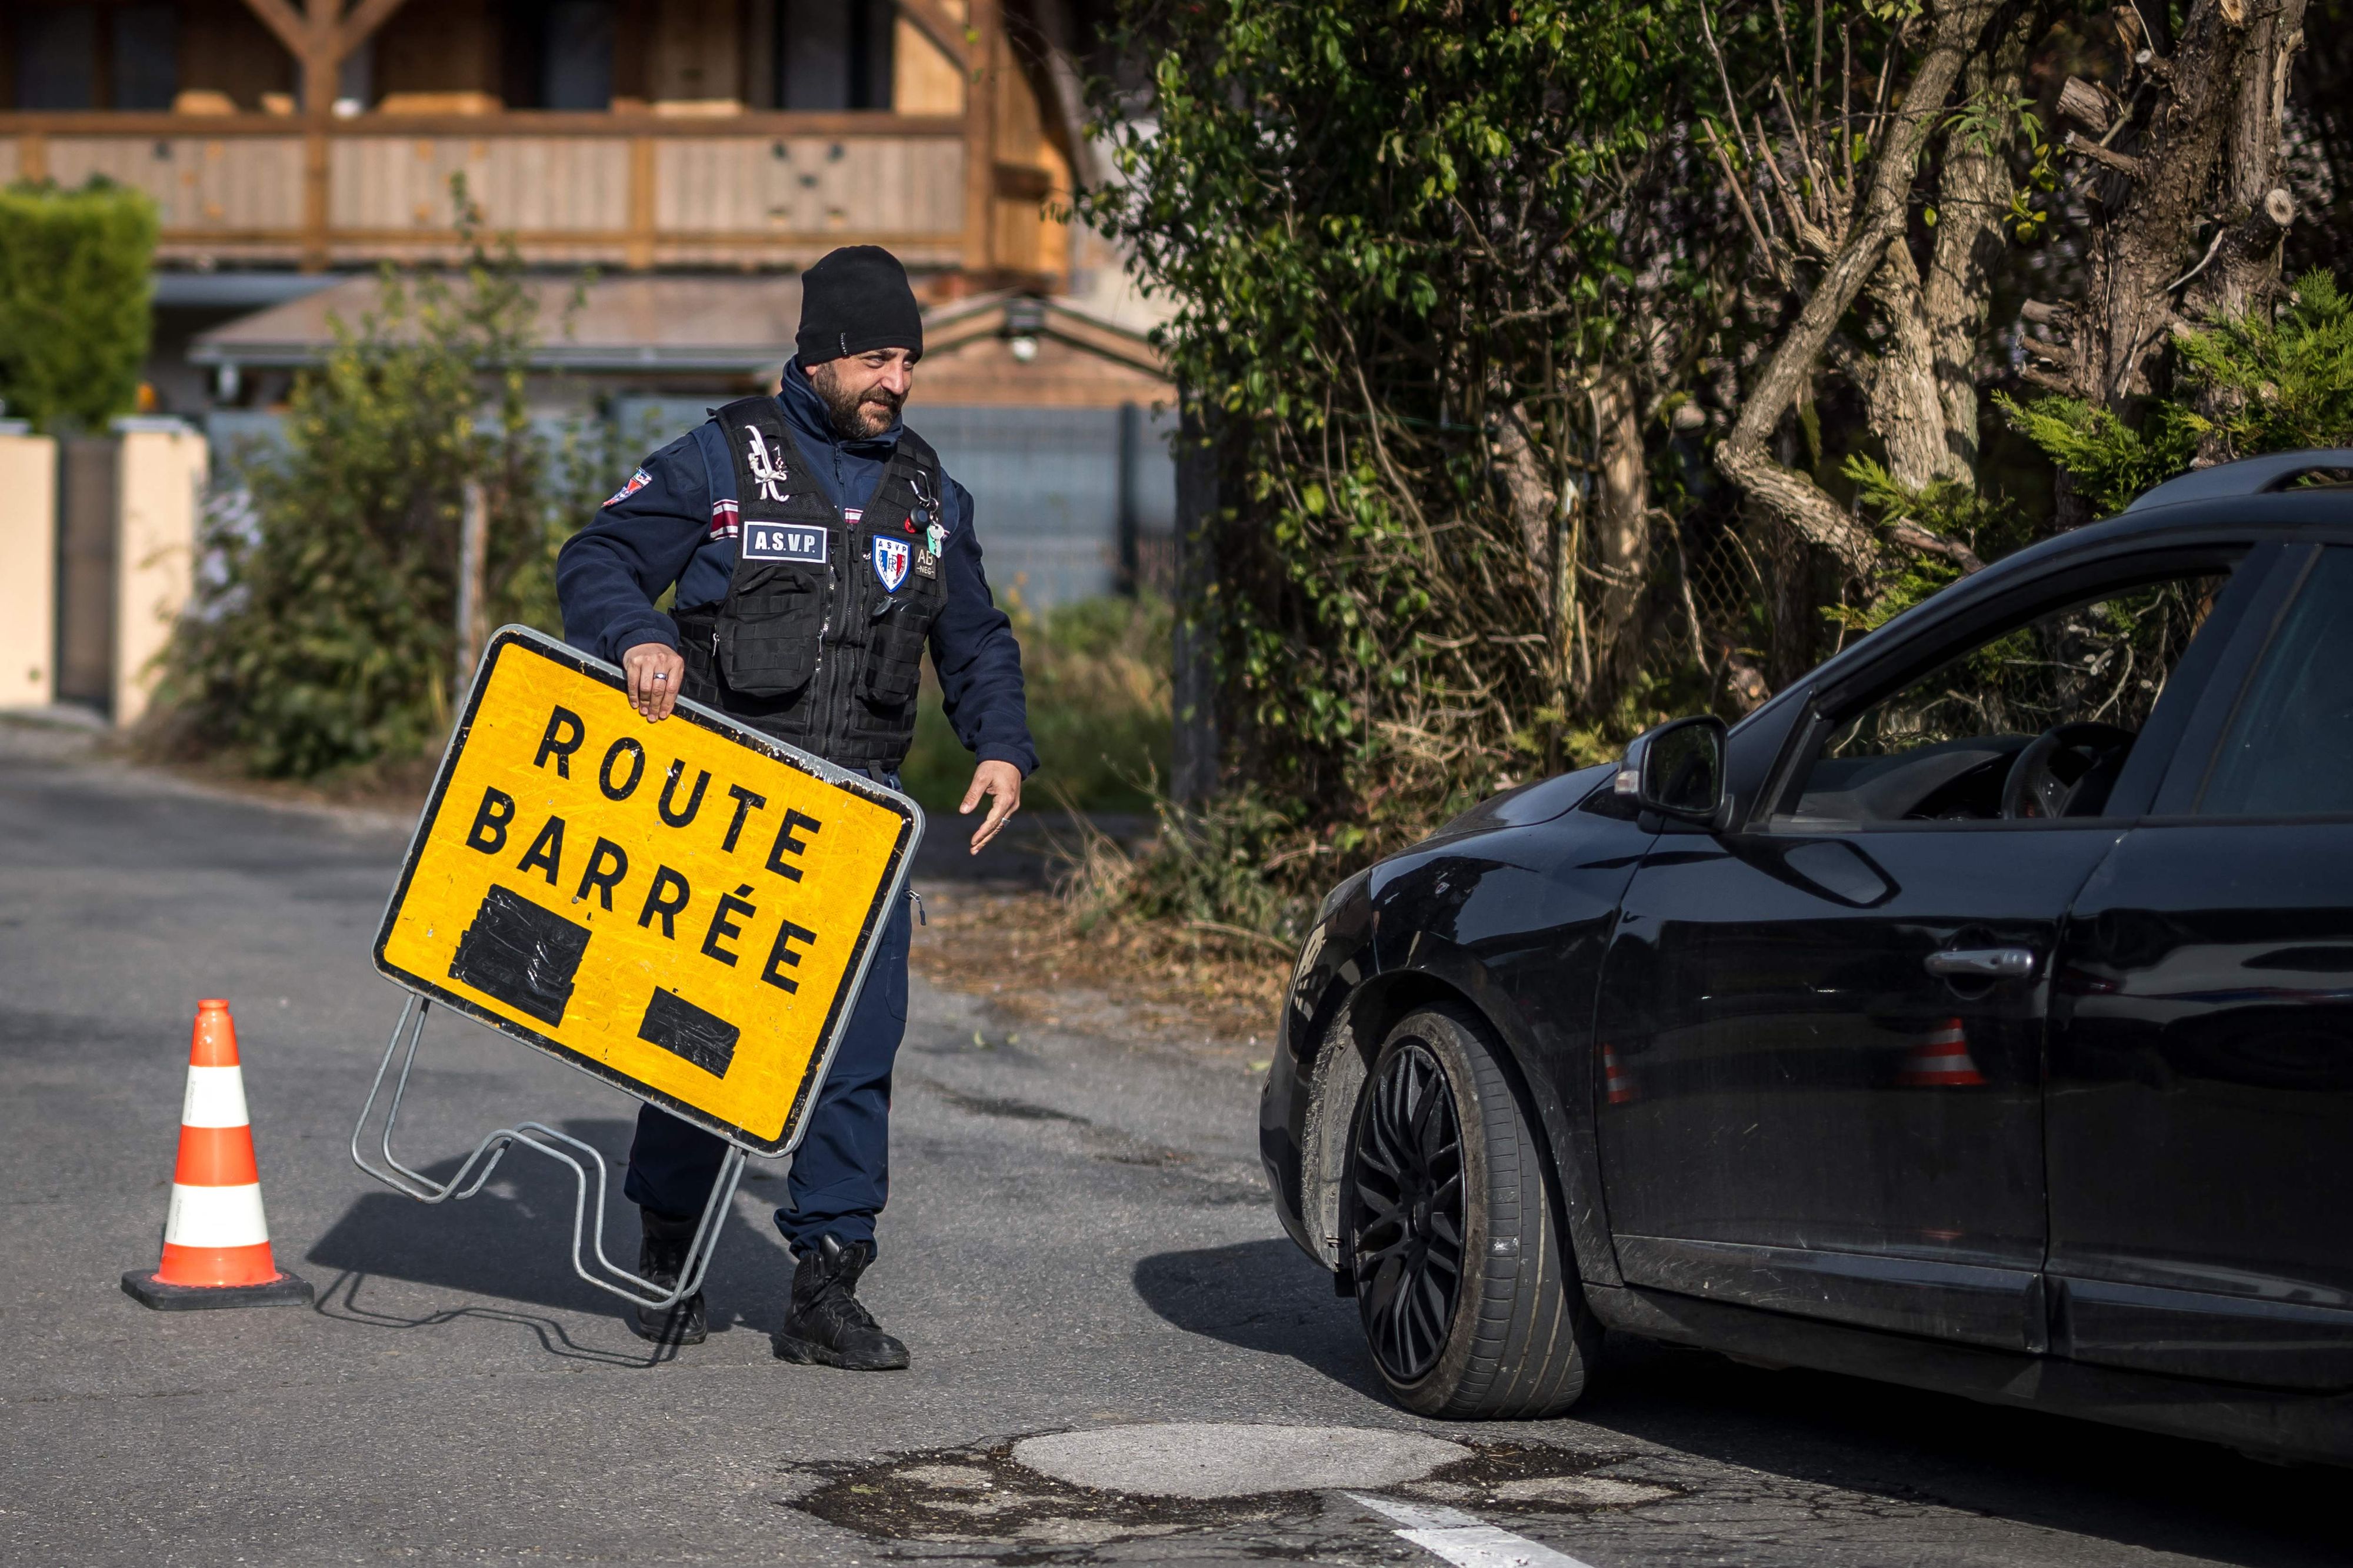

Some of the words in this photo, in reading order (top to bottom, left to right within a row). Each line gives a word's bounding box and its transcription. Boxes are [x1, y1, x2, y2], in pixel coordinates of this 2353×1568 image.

[755, 531, 815, 553] A.S.V.P.
[878, 541, 907, 553] ASVP
[918, 549, 933, 566] AB
[534, 705, 821, 883] ROUTE
[466, 786, 816, 995] BARRÉE
